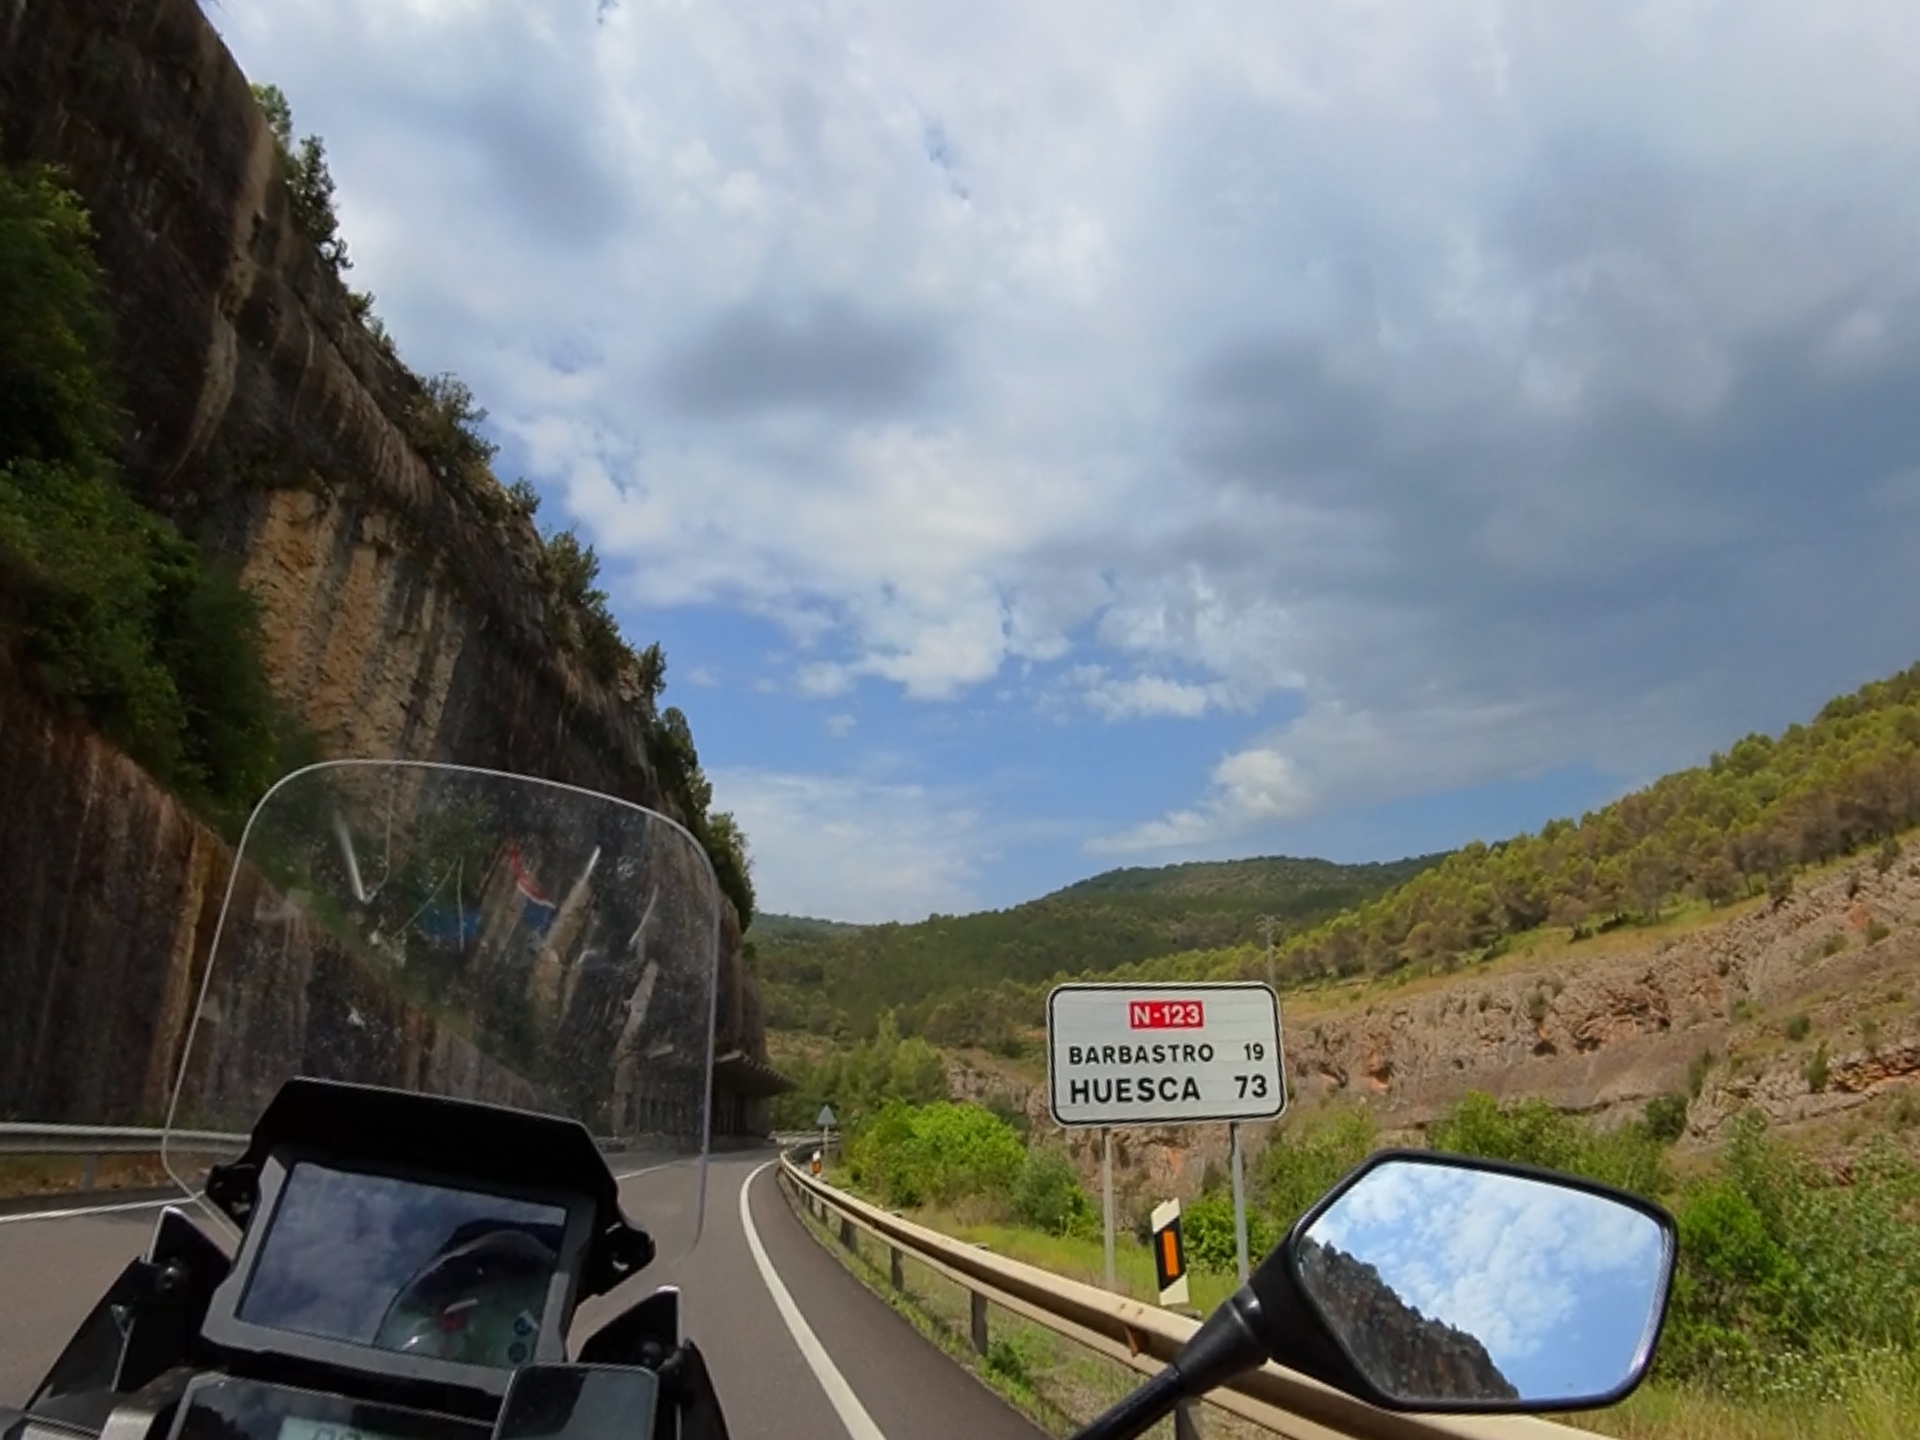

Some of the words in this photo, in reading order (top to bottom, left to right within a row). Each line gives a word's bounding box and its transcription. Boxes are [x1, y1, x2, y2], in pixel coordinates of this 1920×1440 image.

[1133, 1004, 1201, 1026] N-123
[1068, 1043, 1215, 1065] BARBASTRO
[1243, 1042, 1265, 1062] 19
[1069, 1076, 1201, 1105] HUESCA
[1234, 1073, 1268, 1099] 73
